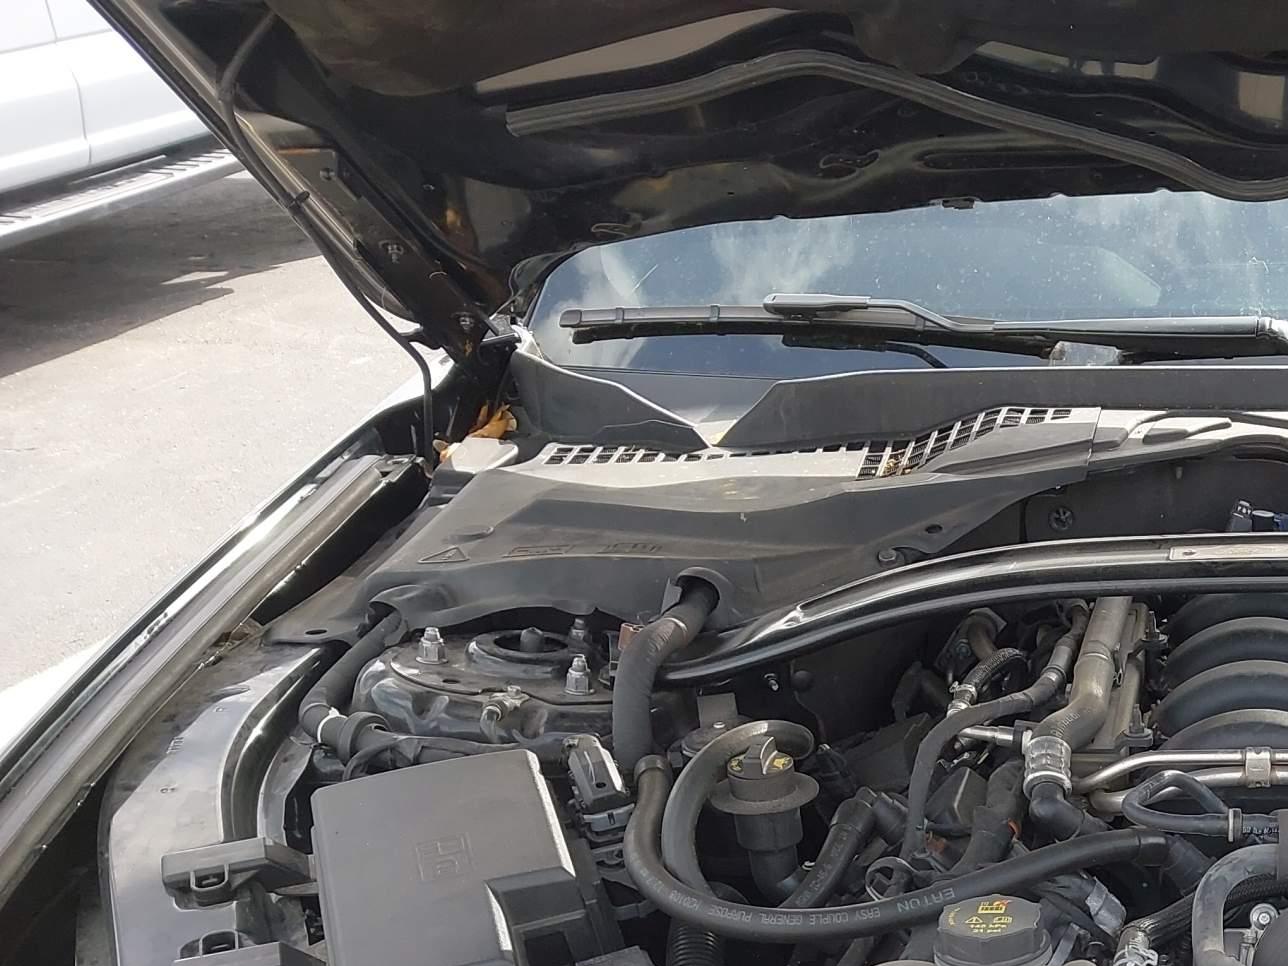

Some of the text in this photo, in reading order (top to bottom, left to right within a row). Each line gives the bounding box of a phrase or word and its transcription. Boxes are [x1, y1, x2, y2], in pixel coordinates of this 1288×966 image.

[896, 887, 956, 913] EATON
[707, 904, 752, 924] PURPOSE
[759, 911, 803, 926] GENERAL
[809, 911, 849, 926] COUPLE
[852, 906, 881, 923] EASY
